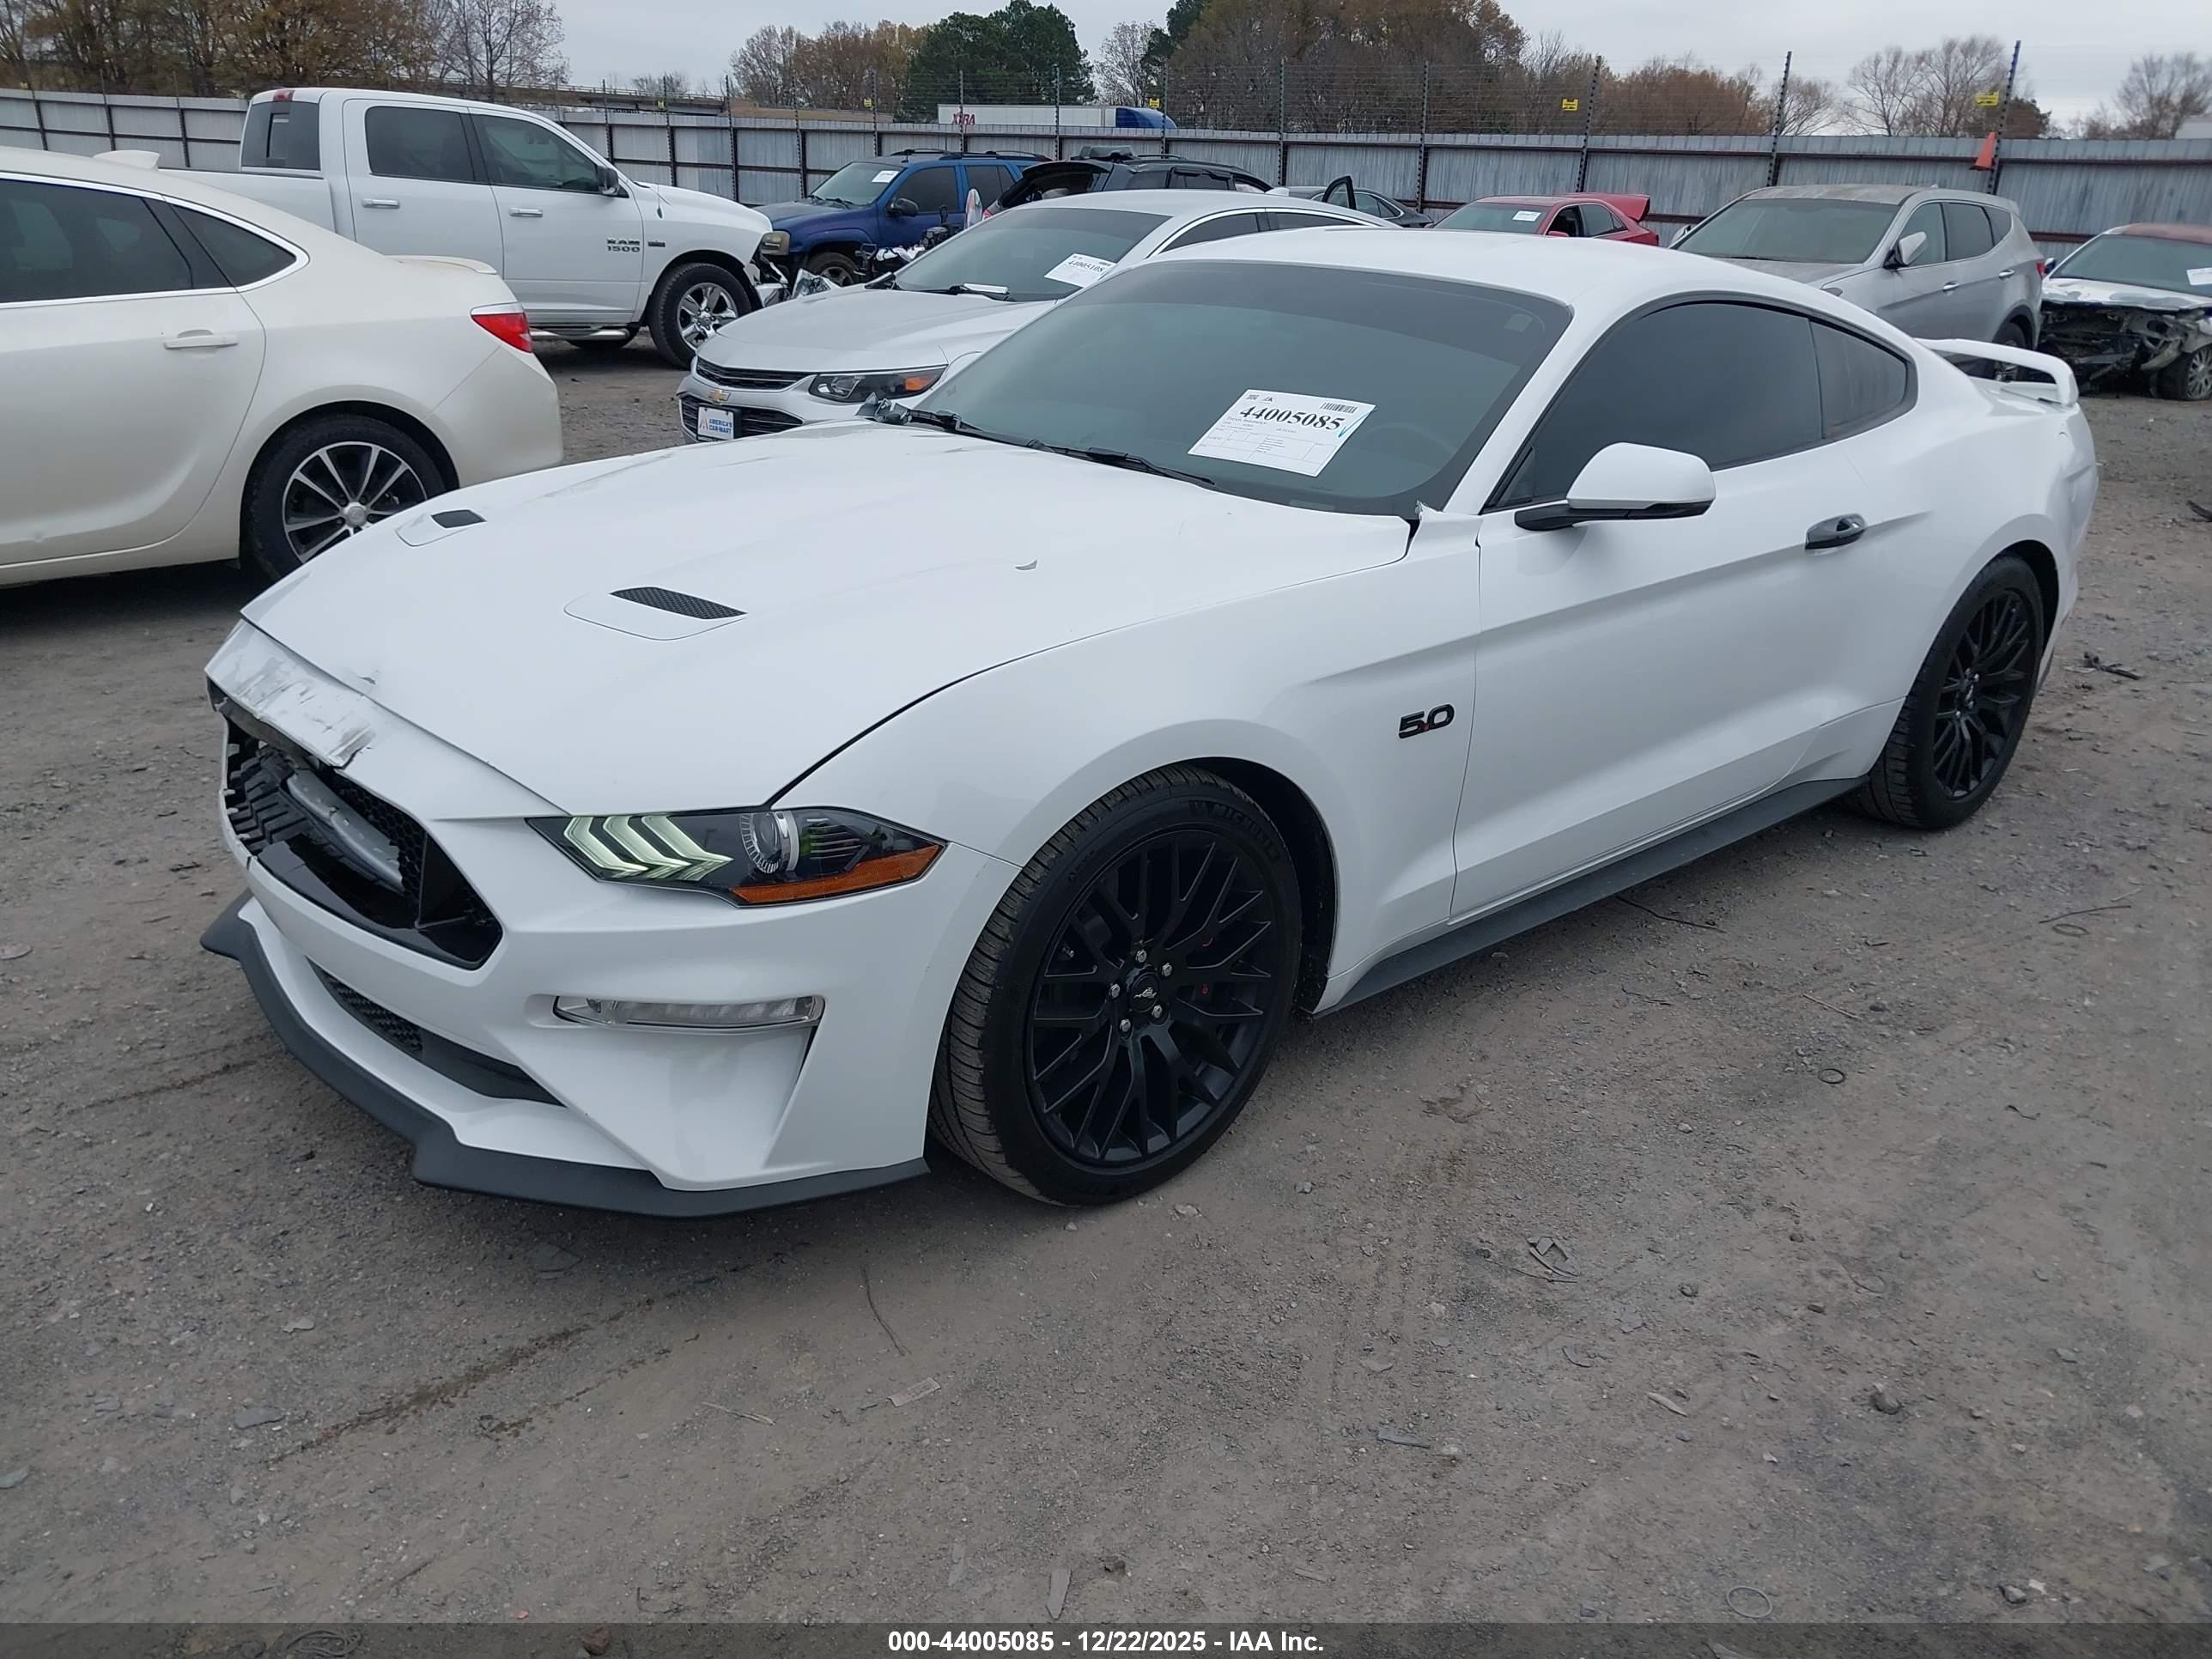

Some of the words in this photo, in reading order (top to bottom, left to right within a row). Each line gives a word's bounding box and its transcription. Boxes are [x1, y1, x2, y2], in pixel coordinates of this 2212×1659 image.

[709, 418, 732, 428] AMERICA'S
[1240, 405, 1346, 431] 44005085
[1399, 703, 1455, 739] 5.0
